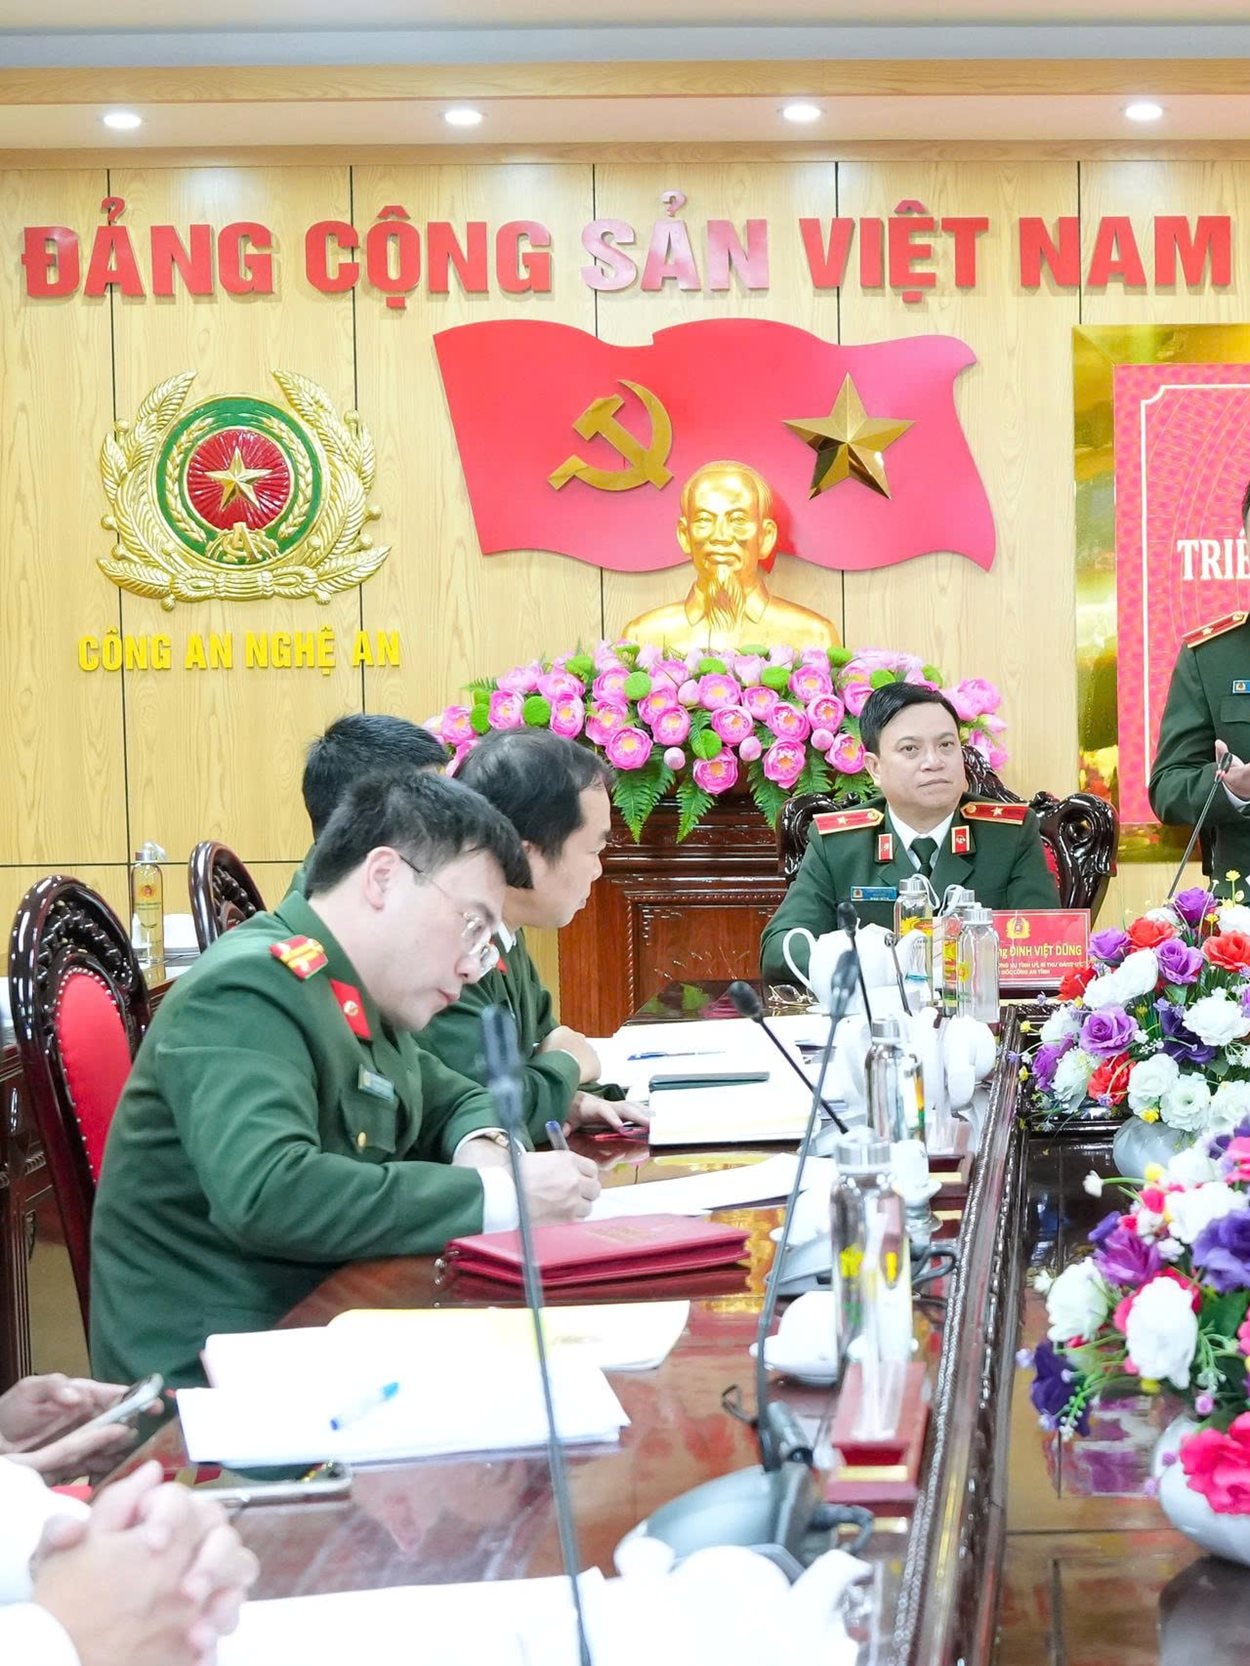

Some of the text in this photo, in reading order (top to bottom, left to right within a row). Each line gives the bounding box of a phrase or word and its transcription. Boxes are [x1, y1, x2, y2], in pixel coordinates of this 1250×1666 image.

[22, 197, 273, 299] ĐẢNG
[305, 205, 551, 309] CỘNG
[581, 191, 768, 291] SẢN
[799, 200, 989, 302] VIỆT
[1019, 215, 1231, 287] NAM
[77, 625, 401, 675] CÔNG AN NGHỆ AN
